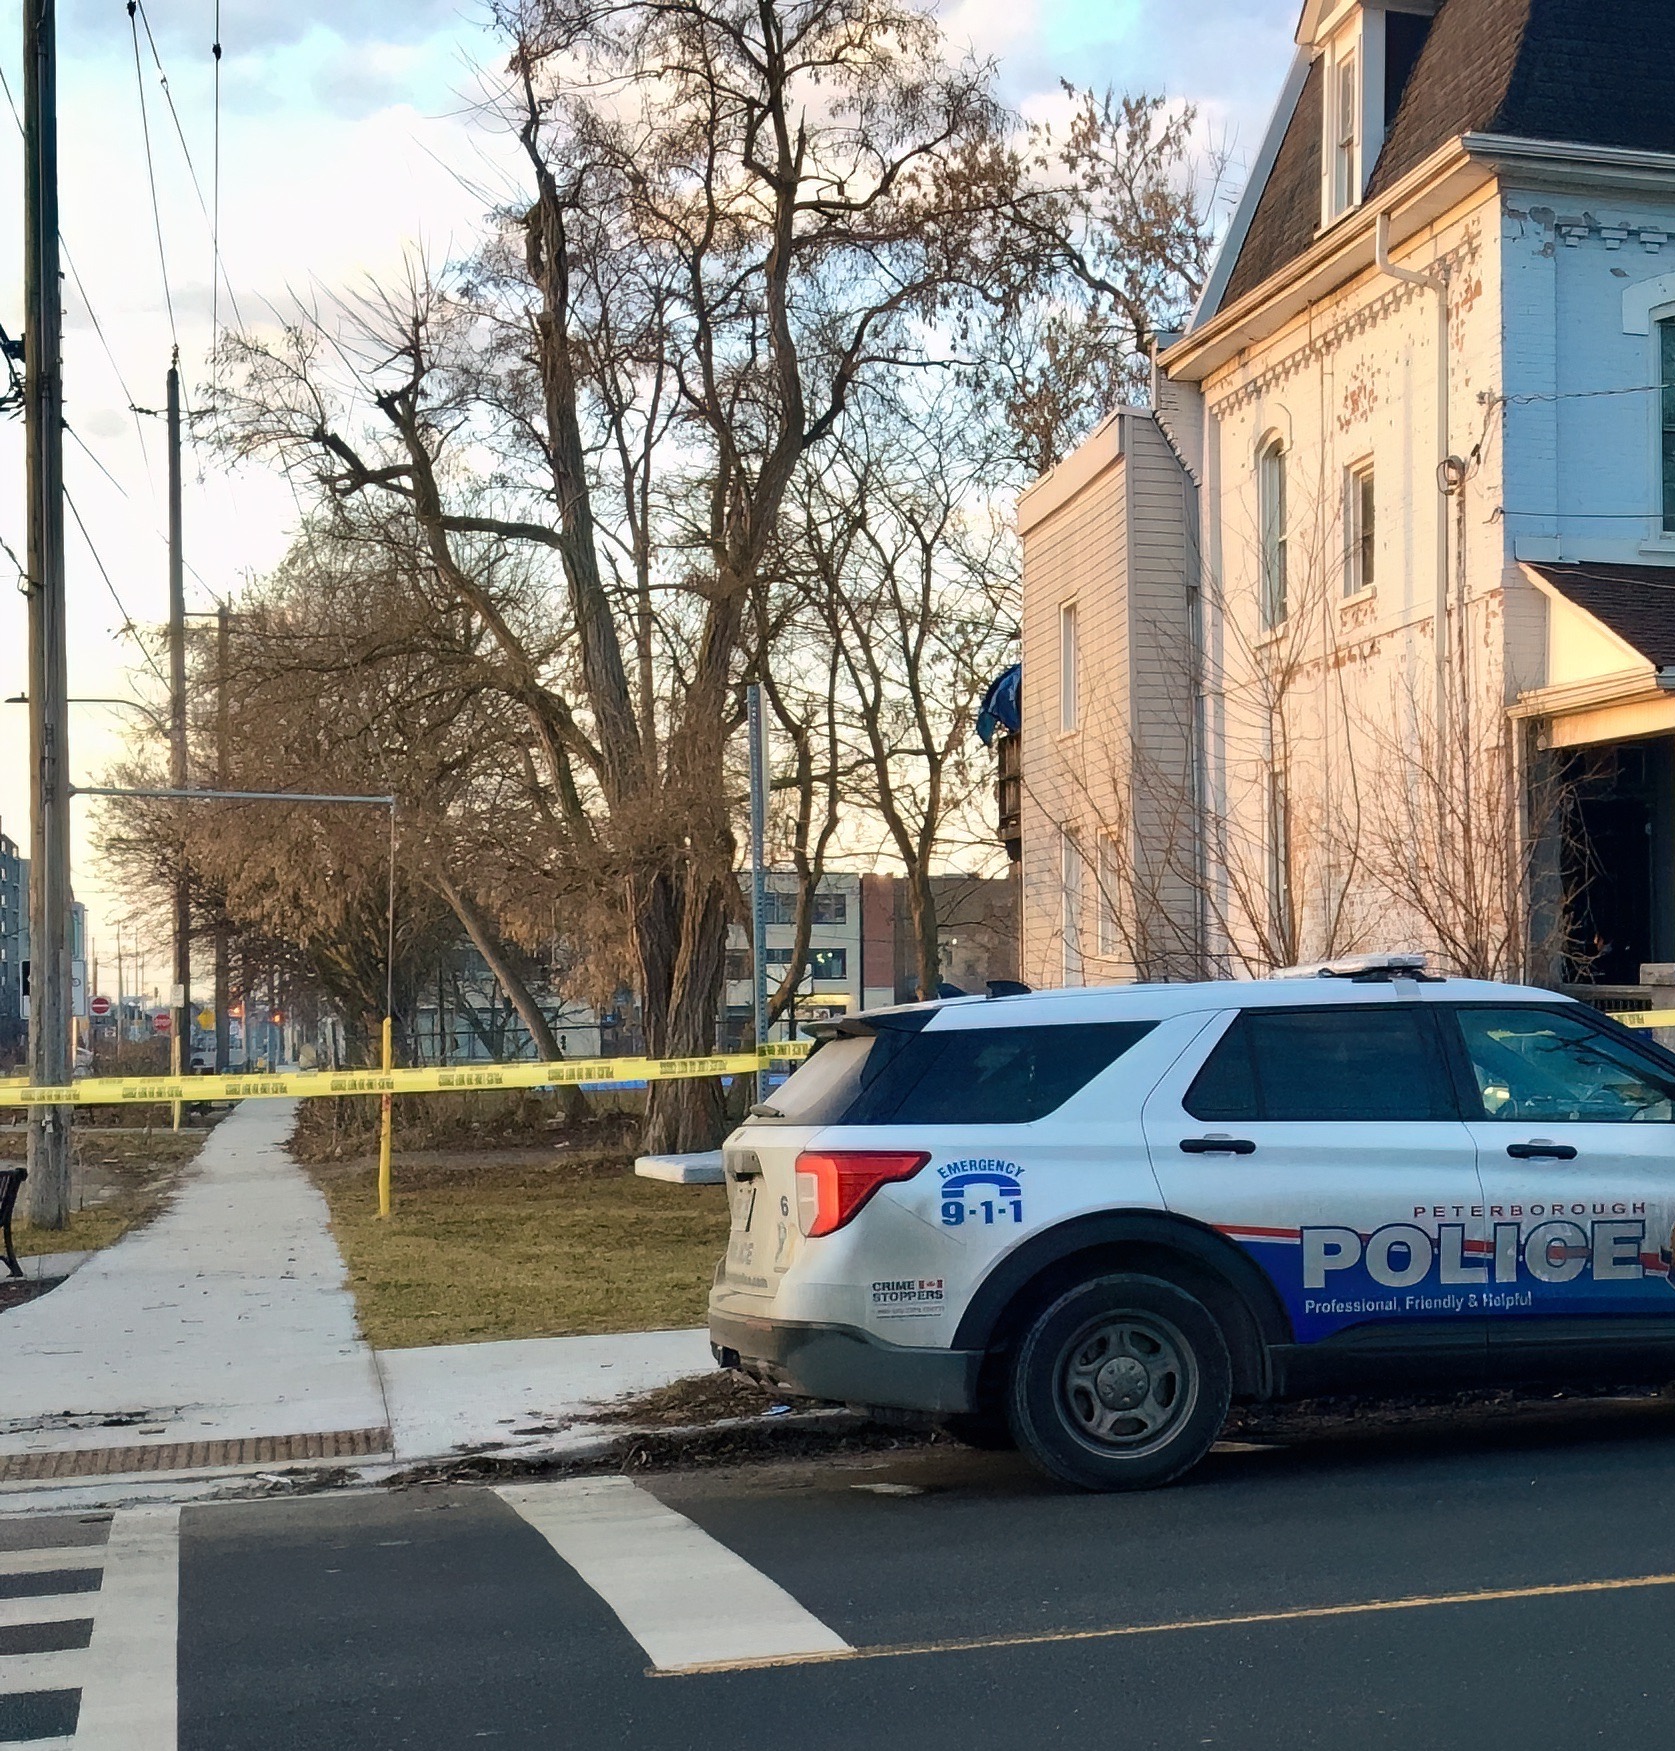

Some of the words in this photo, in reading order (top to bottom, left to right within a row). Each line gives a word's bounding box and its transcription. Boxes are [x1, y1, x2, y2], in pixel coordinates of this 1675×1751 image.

[937, 1159, 1026, 1179] EMERGENCY
[780, 1195, 789, 1217] 6
[941, 1200, 1022, 1226] 9-1-1
[1413, 1202, 1645, 1218] PETERBOROUGH
[1300, 1219, 1646, 1289] POLICE
[872, 1280, 915, 1291] CRIME
[872, 1290, 943, 1302] STOPPERS
[1305, 1297, 1401, 1314] Professional,
[1405, 1294, 1464, 1312] Friendly
[1468, 1294, 1478, 1308] &
[1483, 1291, 1532, 1310] Helpful
